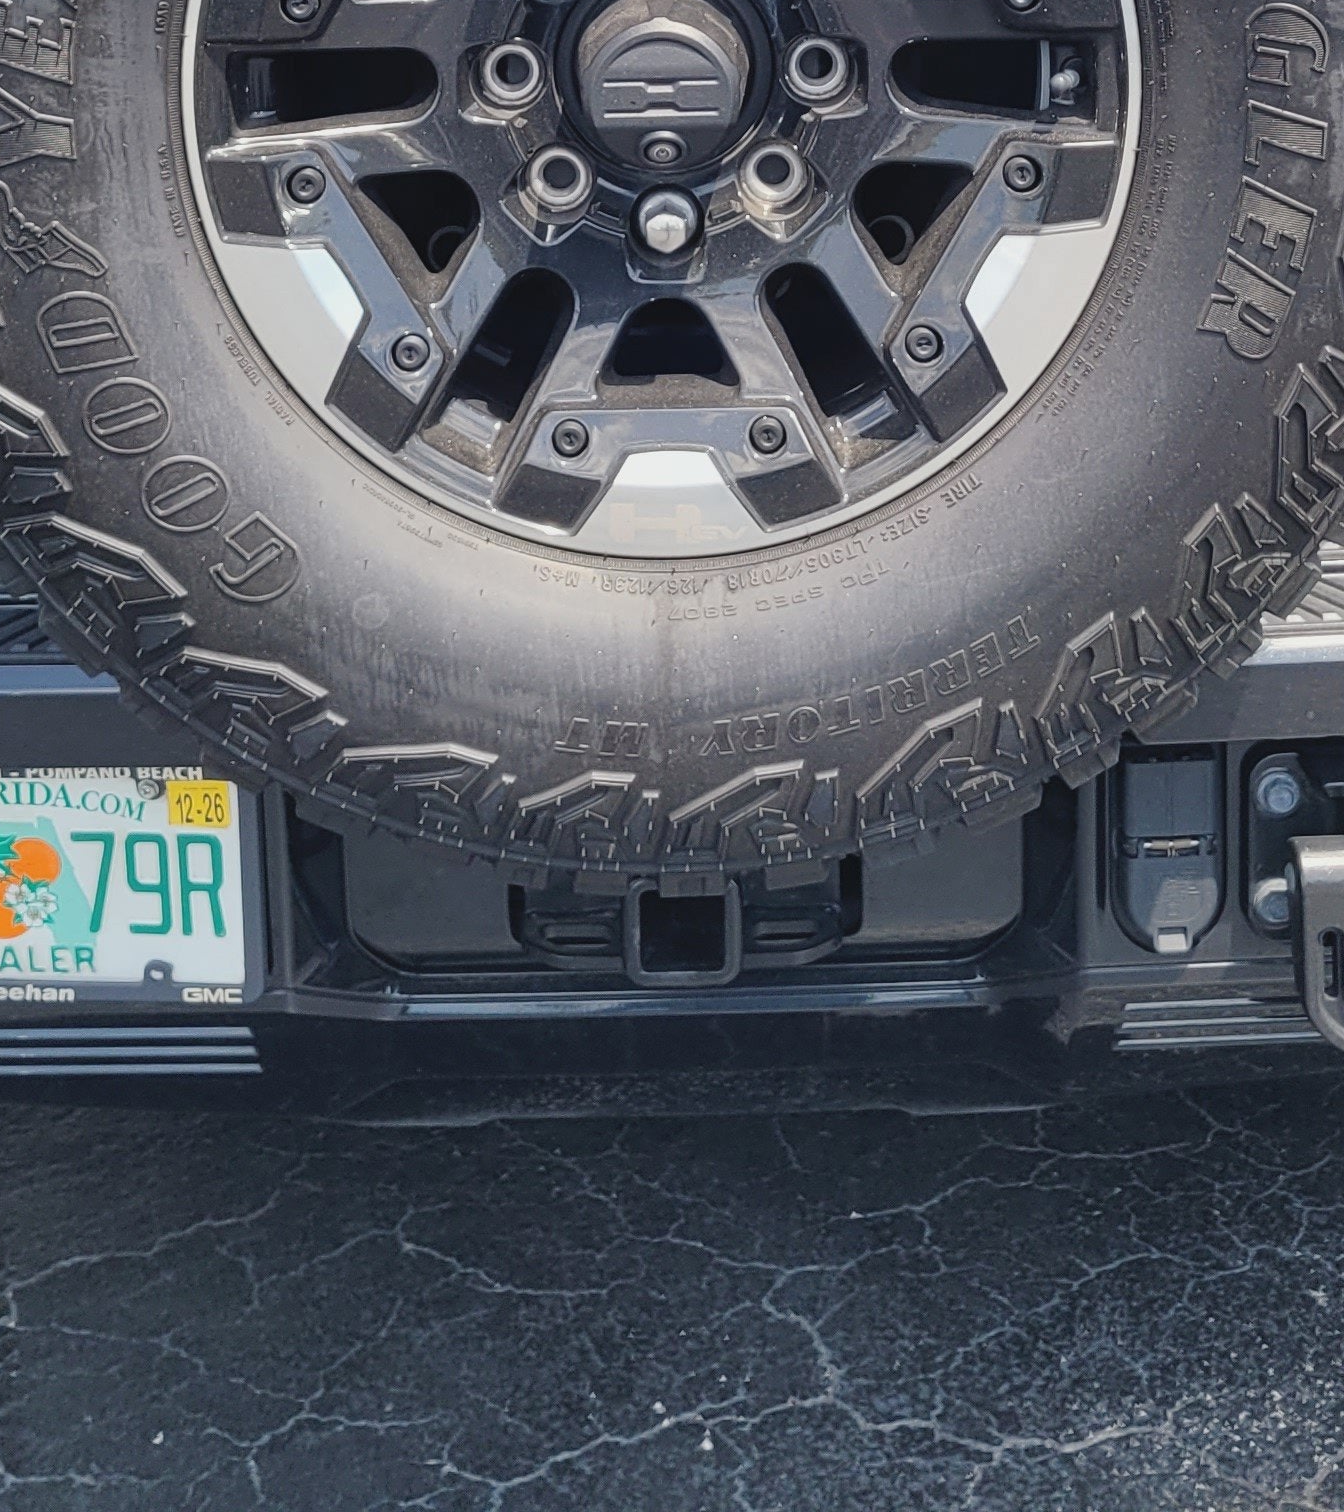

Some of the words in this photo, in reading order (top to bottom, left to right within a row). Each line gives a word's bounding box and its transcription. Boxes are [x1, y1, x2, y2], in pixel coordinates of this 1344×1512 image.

[938, 470, 983, 509] TIRE
[837, 556, 892, 593] TPC
[754, 583, 825, 612] SPEC
[701, 613, 1040, 758] TERRITORY
[551, 712, 650, 759] MT
[136, 766, 203, 780] BEACH
[175, 792, 225, 824] 12-26
[70, 832, 227, 937] 79R
[181, 987, 244, 1004] GMC
